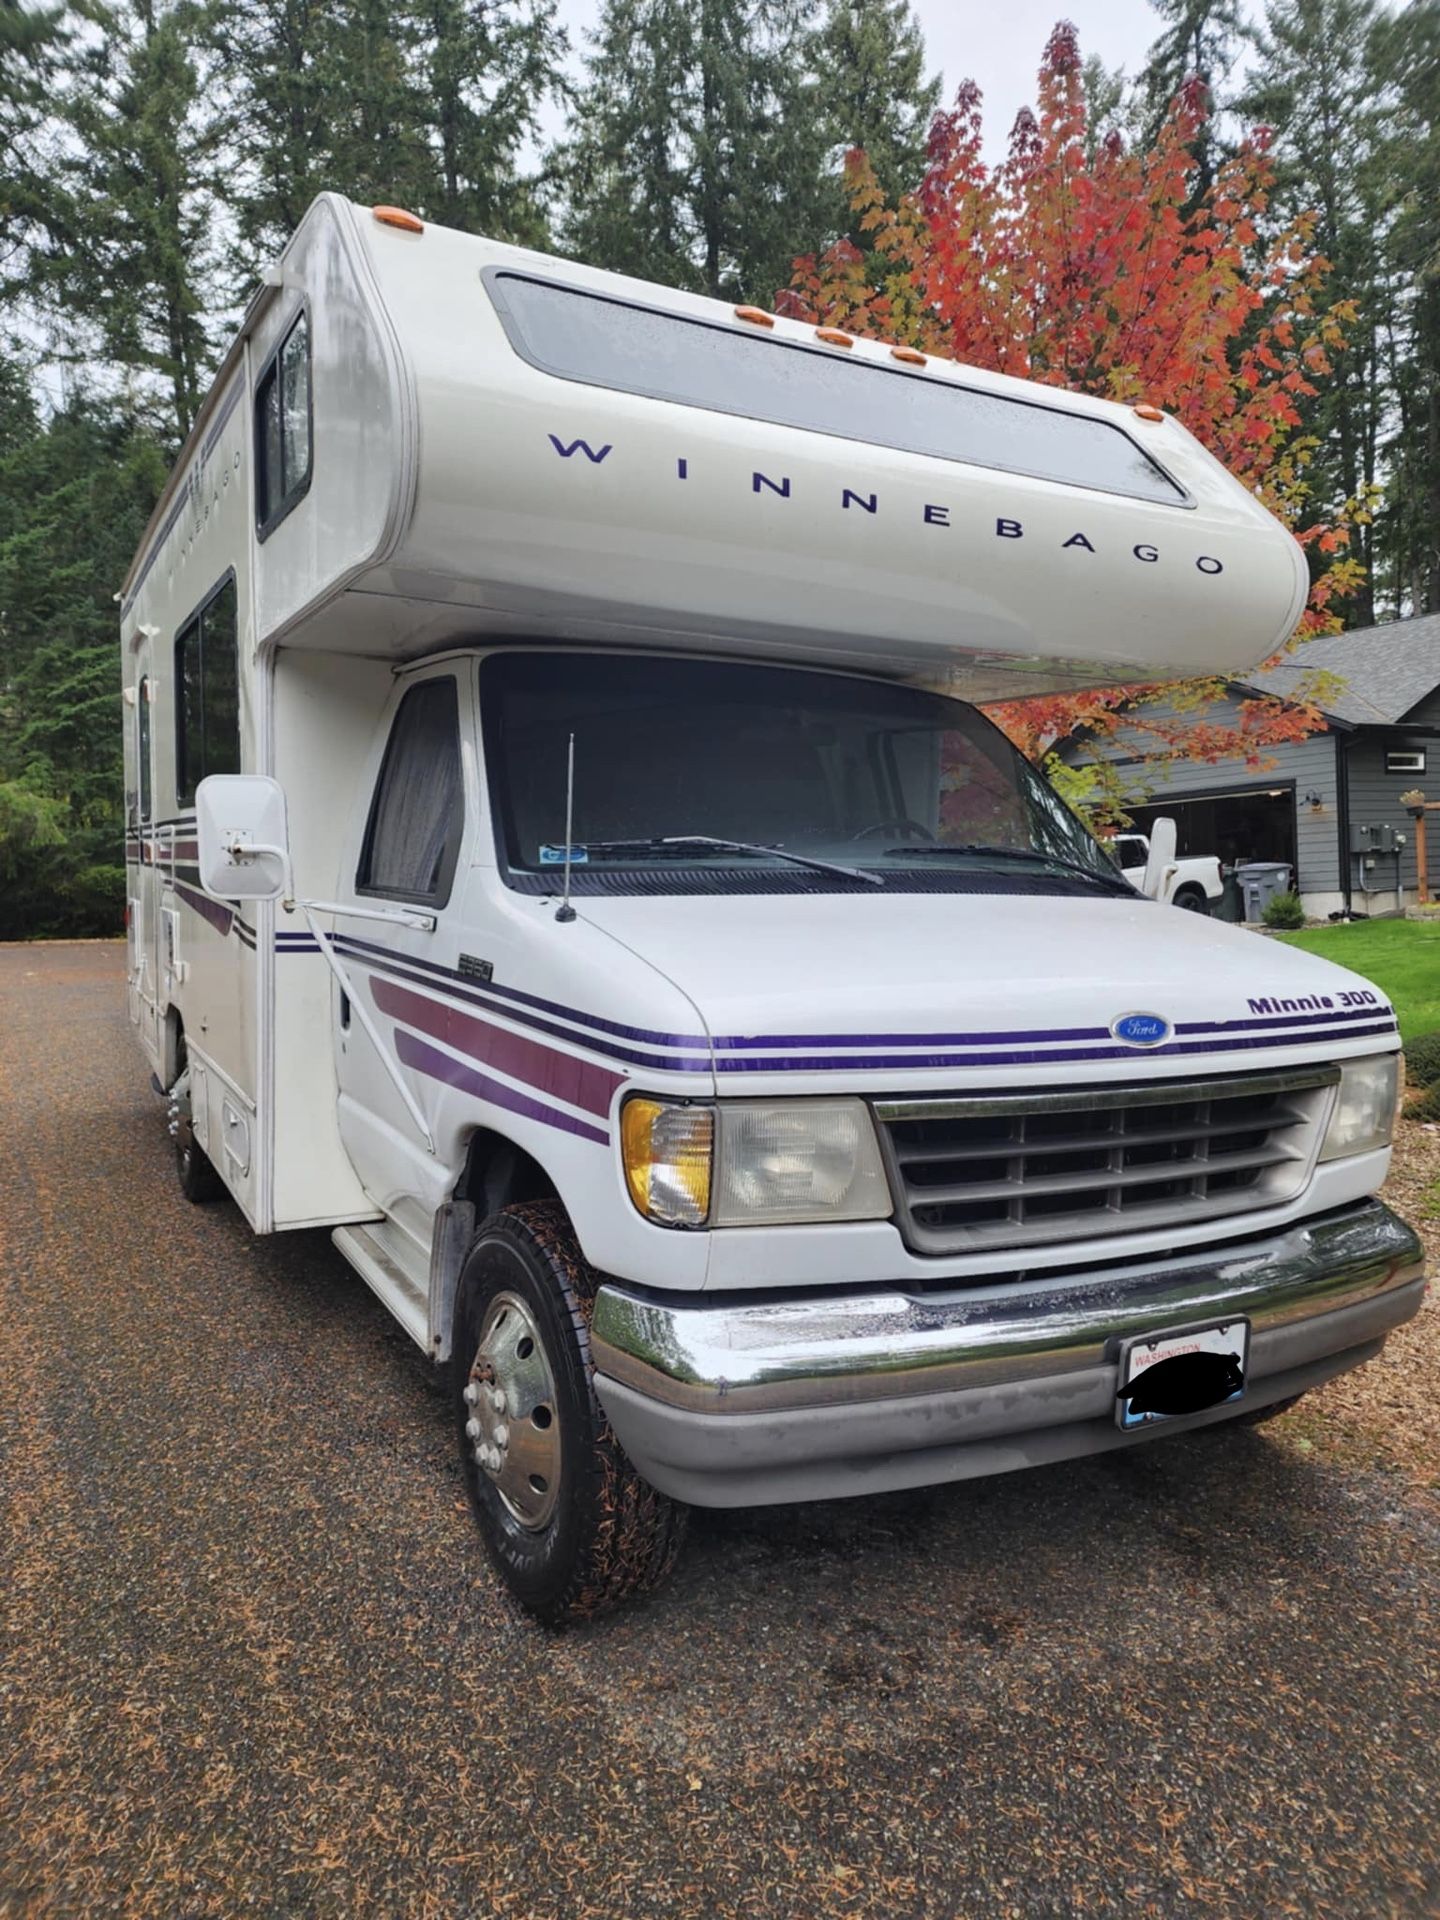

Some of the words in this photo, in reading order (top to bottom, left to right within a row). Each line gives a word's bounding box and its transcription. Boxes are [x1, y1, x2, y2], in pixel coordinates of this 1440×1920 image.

[548, 434, 1224, 575] WINNEBAGO
[1335, 990, 1378, 1007] 300
[1128, 1019, 1159, 1036] Ford
[1135, 1343, 1200, 1367] WASHINGTON
